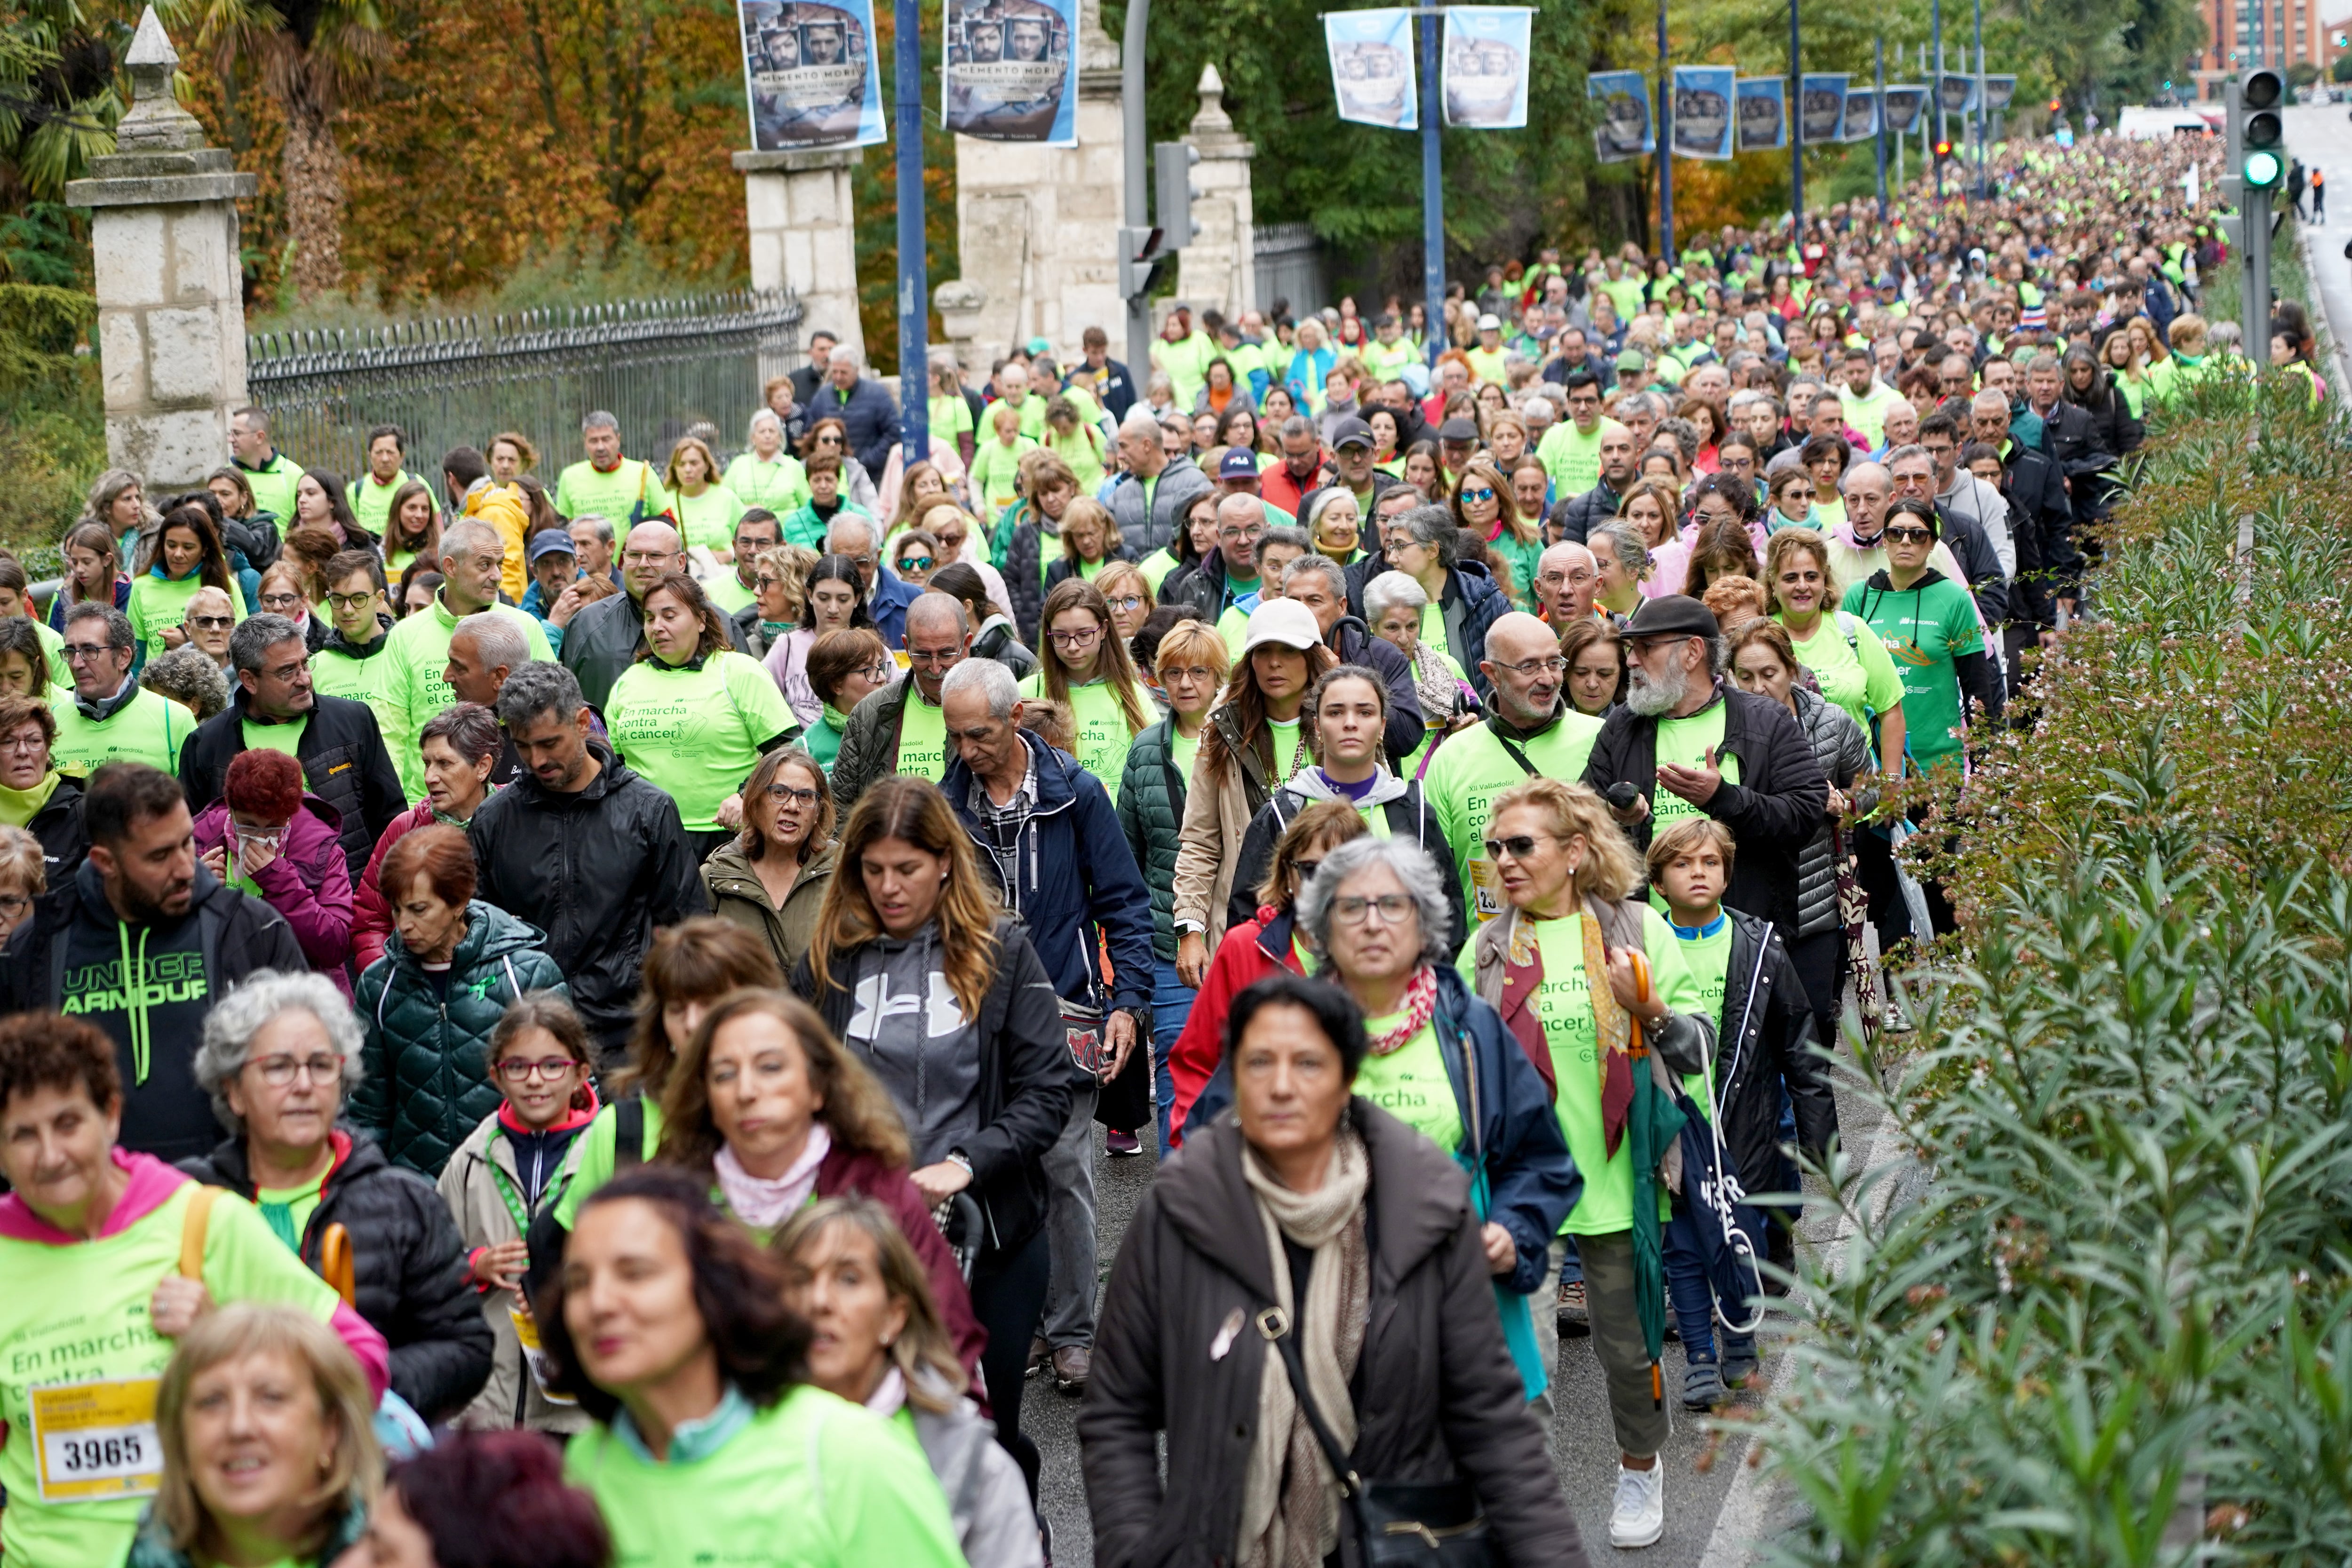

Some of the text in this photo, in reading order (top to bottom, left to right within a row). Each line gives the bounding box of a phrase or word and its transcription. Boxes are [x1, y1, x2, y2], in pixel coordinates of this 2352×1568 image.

[762, 68, 855, 82] MEMENTO MORI
[1228, 456, 1249, 466] FILA
[425, 669, 440, 679] En
[428, 693, 439, 704] el
[624, 706, 686, 718] En marcha
[620, 717, 657, 729] contra
[620, 729, 676, 741] el cáncer
[1076, 730, 1105, 740] rcha
[1480, 780, 1514, 790] Valladolid
[1468, 797, 1486, 811] En
[1653, 801, 1696, 816] cánce
[1470, 828, 1483, 842] el
[1542, 1018, 1585, 1032] ncer
[12, 1350, 41, 1375] En
[64, 1435, 142, 1471] 3965
